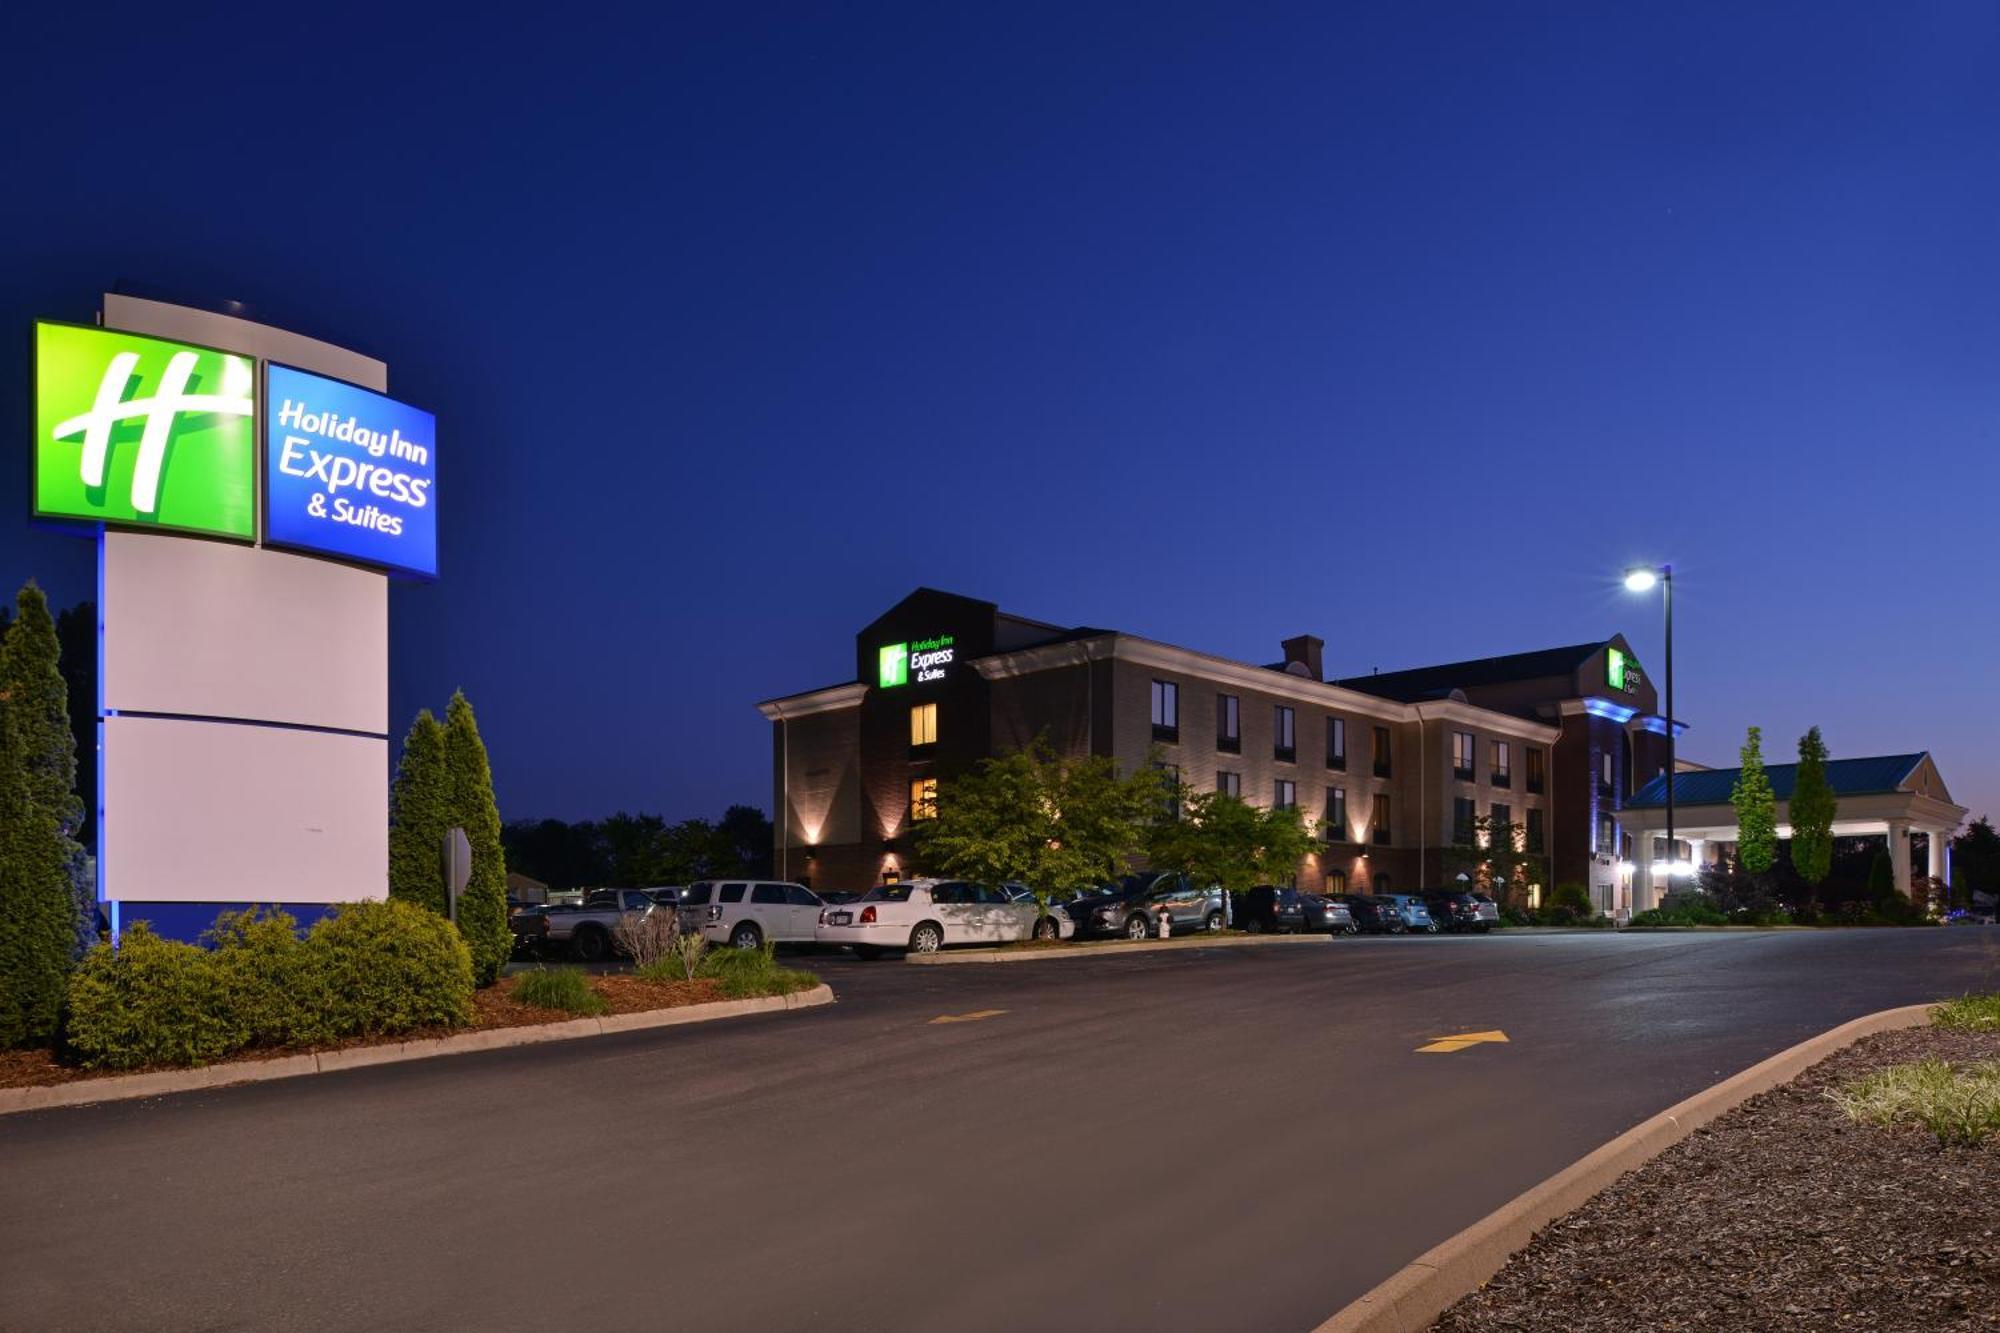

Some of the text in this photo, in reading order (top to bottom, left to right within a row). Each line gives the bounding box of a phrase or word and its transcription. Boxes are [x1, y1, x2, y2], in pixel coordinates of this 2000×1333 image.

[278, 399, 428, 466] Holiday Inn
[279, 434, 428, 508] Express
[307, 492, 403, 536] & Suites
[911, 648, 954, 671] Express
[917, 669, 945, 682] & Suites
